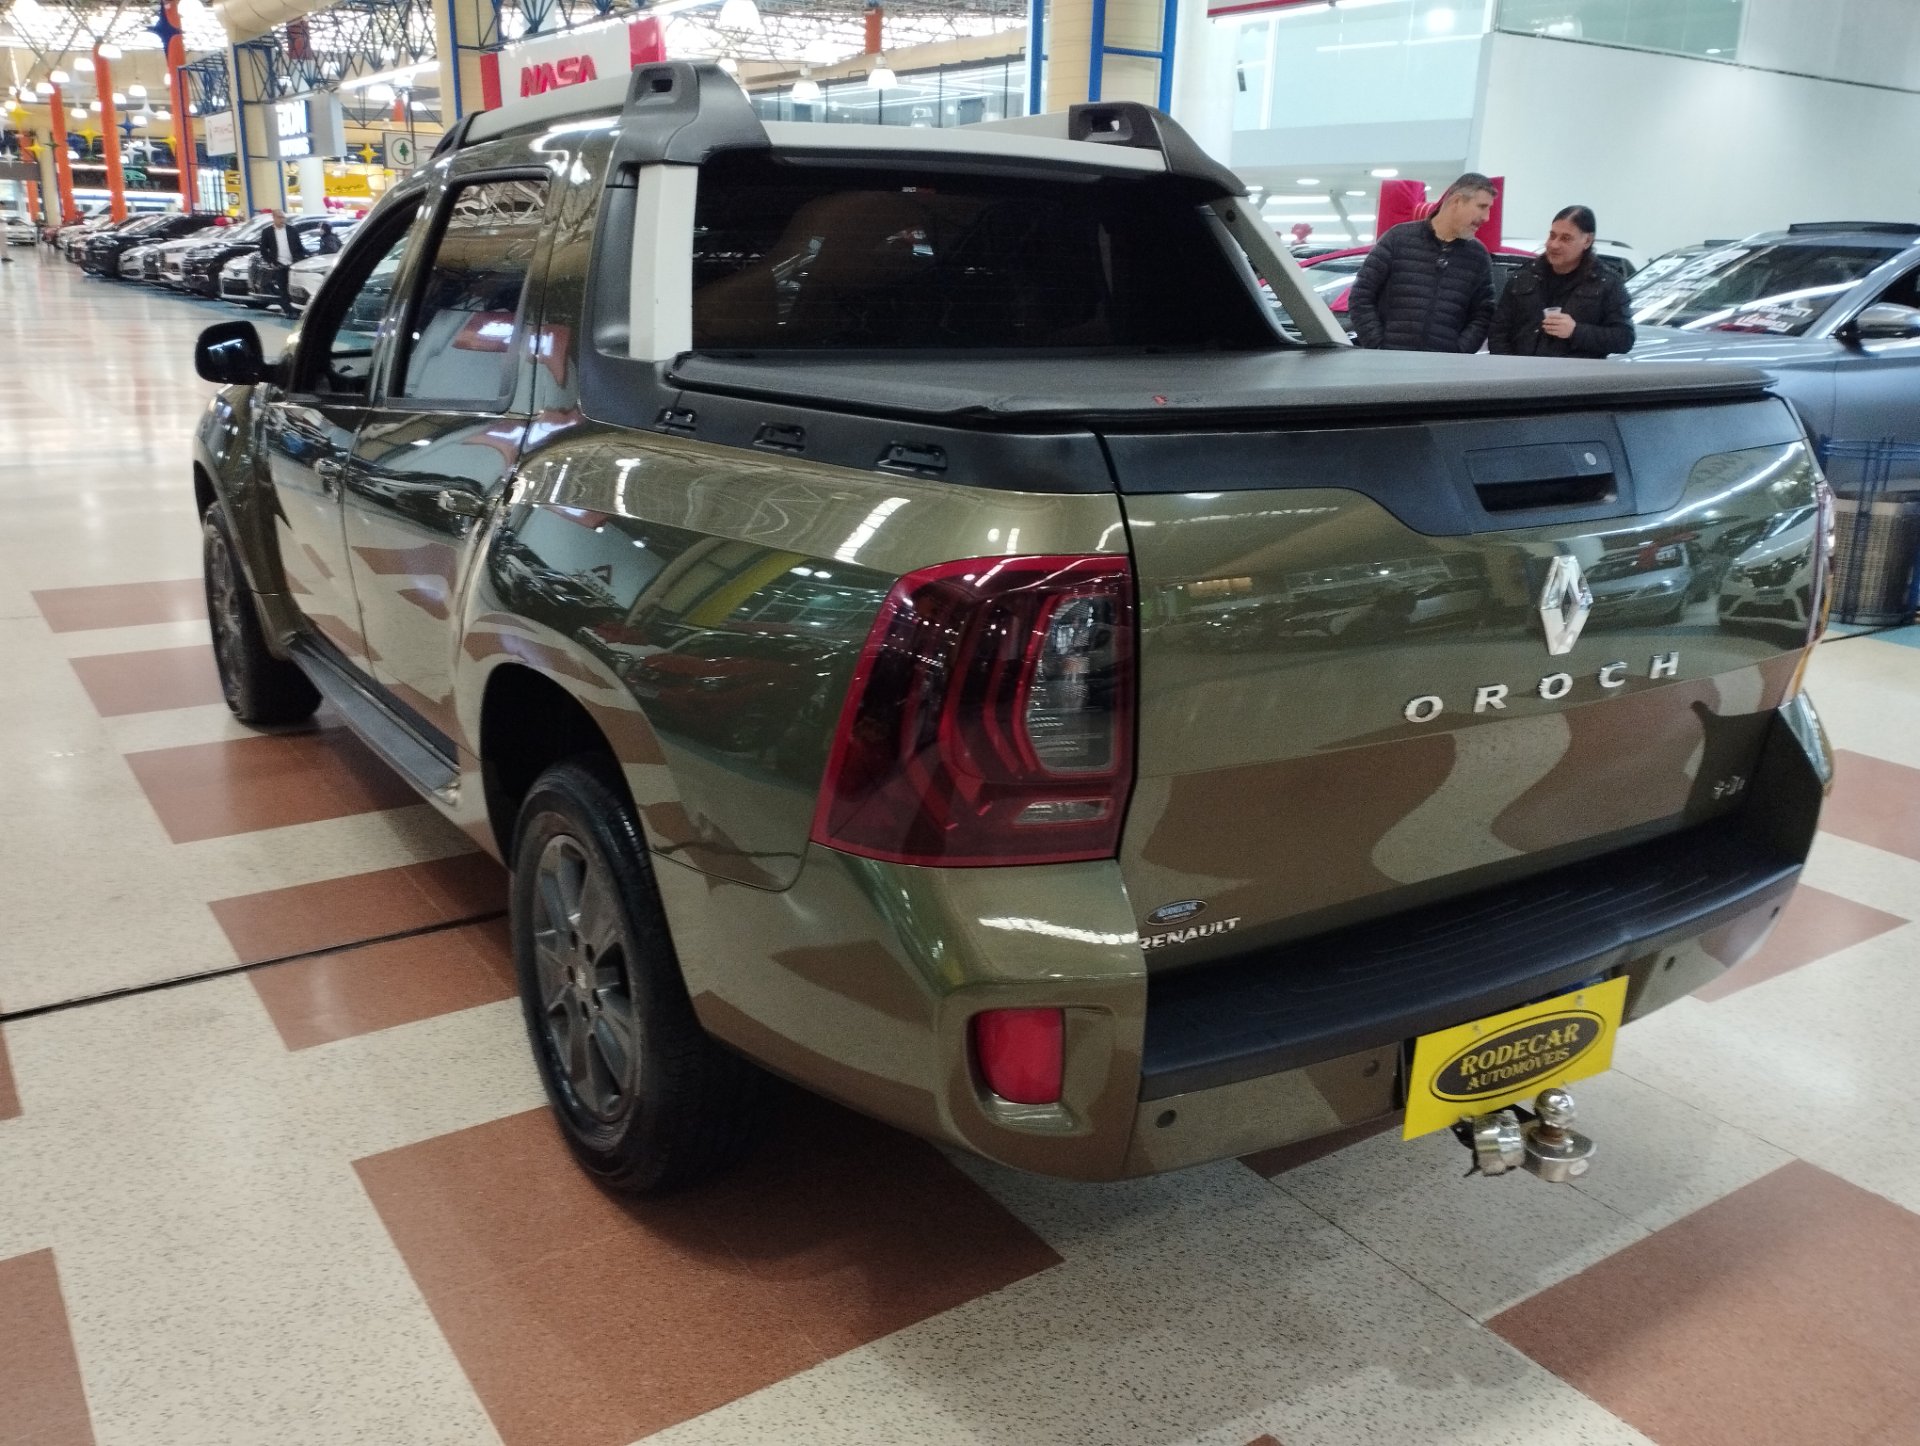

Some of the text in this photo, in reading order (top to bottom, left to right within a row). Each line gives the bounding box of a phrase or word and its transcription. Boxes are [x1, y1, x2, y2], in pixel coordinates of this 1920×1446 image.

[520, 54, 598, 97] NASA
[1404, 651, 1680, 723] OROCH
[1138, 915, 1242, 951] RENAULT
[1460, 1022, 1580, 1076] RODECAR
